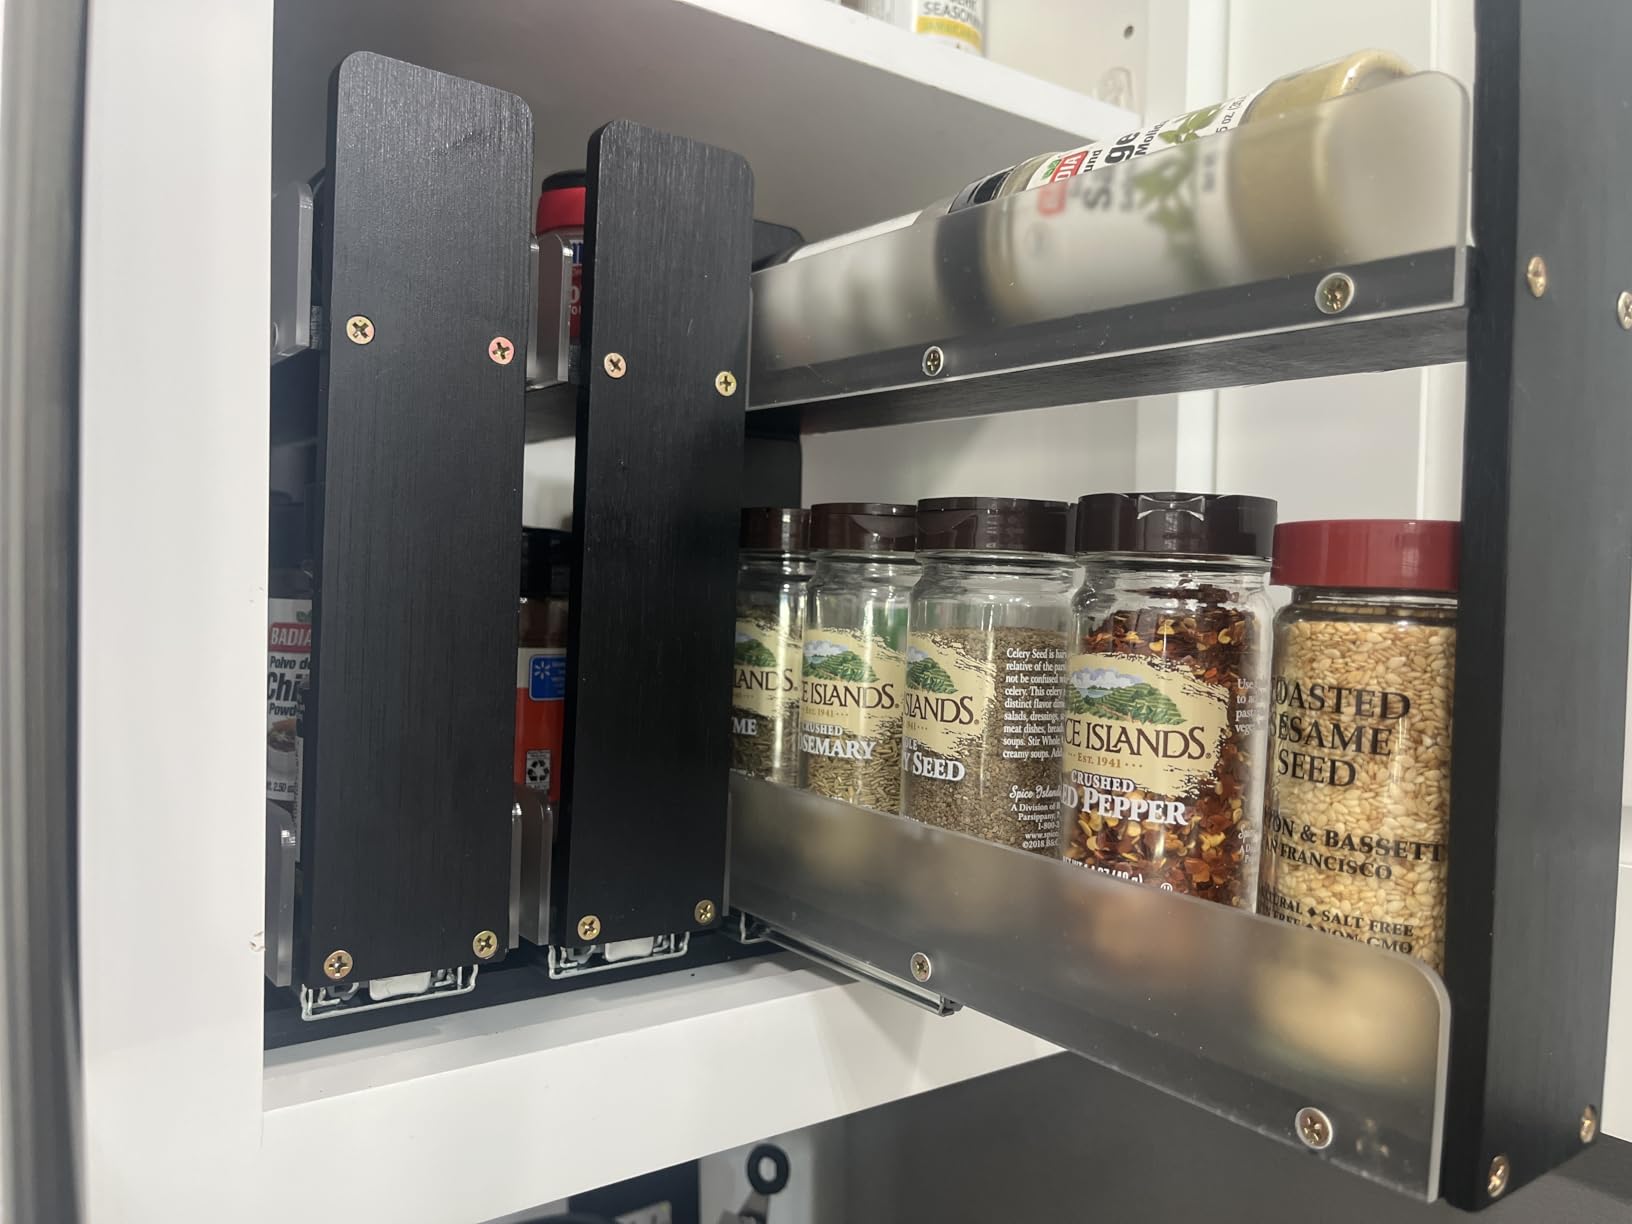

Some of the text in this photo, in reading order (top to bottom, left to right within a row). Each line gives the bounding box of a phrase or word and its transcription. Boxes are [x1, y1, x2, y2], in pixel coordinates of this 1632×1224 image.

[1006, 647, 1031, 661] Celery
[1031, 648, 1048, 659] Seed
[270, 655, 297, 670] Polvo
[1006, 660, 1033, 671] relative
[1034, 660, 1042, 671] of
[1042, 661, 1054, 672] the
[1005, 673, 1019, 683] not
[1020, 673, 1030, 684] be
[1030, 673, 1059, 684] confused
[1004, 686, 1028, 699] celery.
[1029, 686, 1045, 696] This
[1236, 694, 1247, 704] to
[1004, 698, 1032, 709] distinct
[1003, 710, 1029, 723] salads,
[1003, 725, 1022, 733] meat
[1023, 723, 1047, 735] dishes,
[1002, 737, 1026, 749] soups.
[1027, 735, 1040, 746] Stir
[1002, 750, 1030, 761] creamy
[1096, 755, 1121, 769] 1941
[912, 751, 966, 782] SEED
[1278, 748, 1356, 787] SEED
[1071, 769, 1135, 794] CRUSHED
[1009, 784, 1034, 803] Spice
[1010, 803, 1018, 812] A
[1019, 803, 1049, 812] Division
[1081, 785, 1189, 826] PEPPER
[1300, 824, 1317, 844] &
[1324, 829, 1442, 862] BASSETT
[1280, 843, 1392, 881] FRANCISCO
[1321, 909, 1364, 929] SALT
[1369, 918, 1415, 937] FREE
